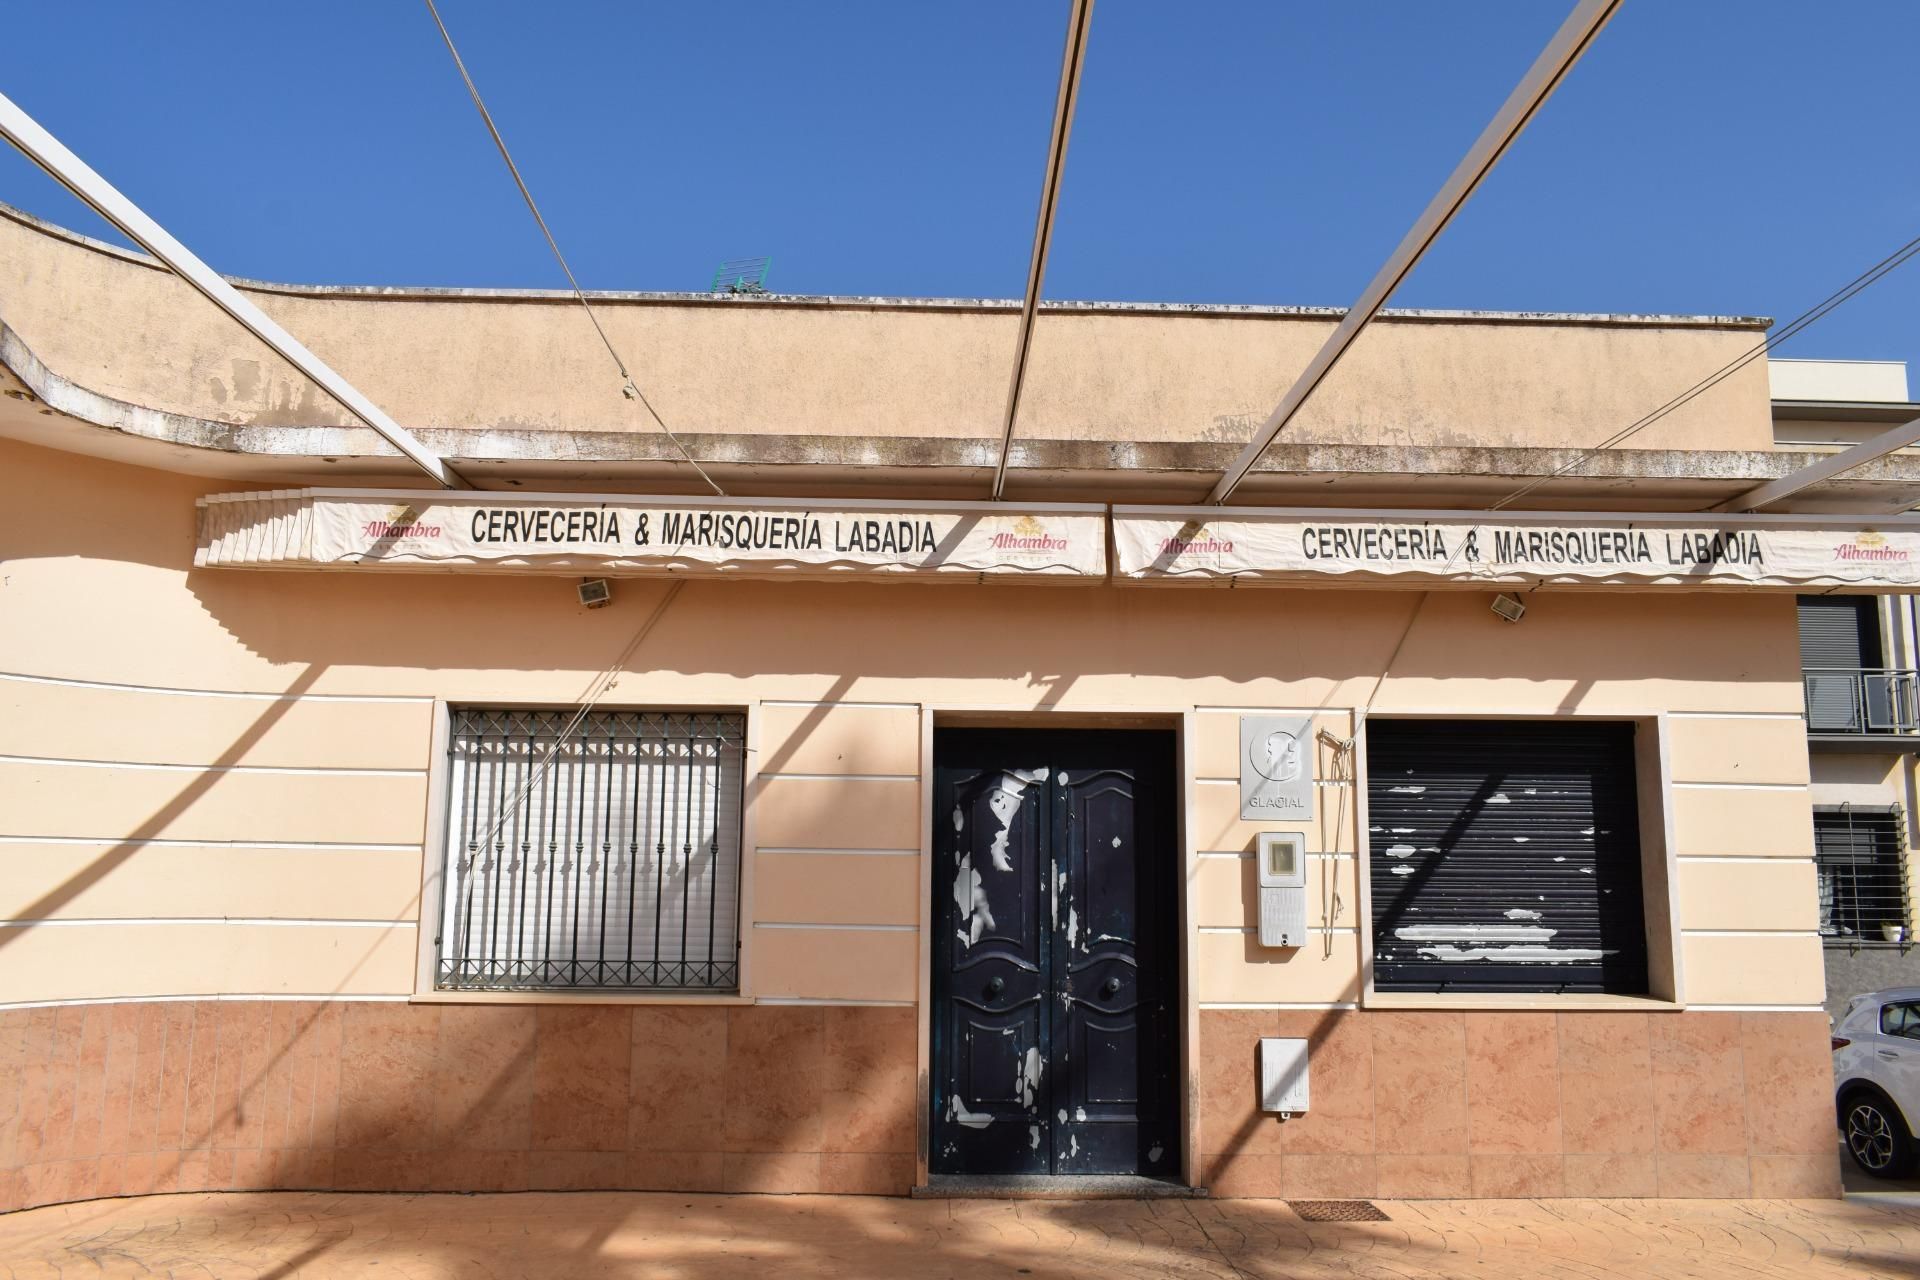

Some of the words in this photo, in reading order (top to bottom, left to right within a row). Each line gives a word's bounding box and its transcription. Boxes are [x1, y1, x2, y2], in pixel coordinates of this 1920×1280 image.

[361, 521, 441, 538] Alhambra
[471, 504, 621, 543] CERVECERÍA
[634, 513, 649, 545] &
[662, 512, 822, 549] MARISQUERÍA
[835, 520, 938, 553] LABADIA
[988, 532, 1067, 551] Alhambra
[1155, 537, 1233, 553] Alhambra
[1302, 521, 1448, 560] CERVECERÍA
[1465, 530, 1480, 563] &
[1494, 524, 1652, 564] MARISQUERÍA
[1666, 532, 1764, 565] LABADIA
[1833, 544, 1908, 561] Alhambra
[1248, 797, 1304, 808] GLACIAL
